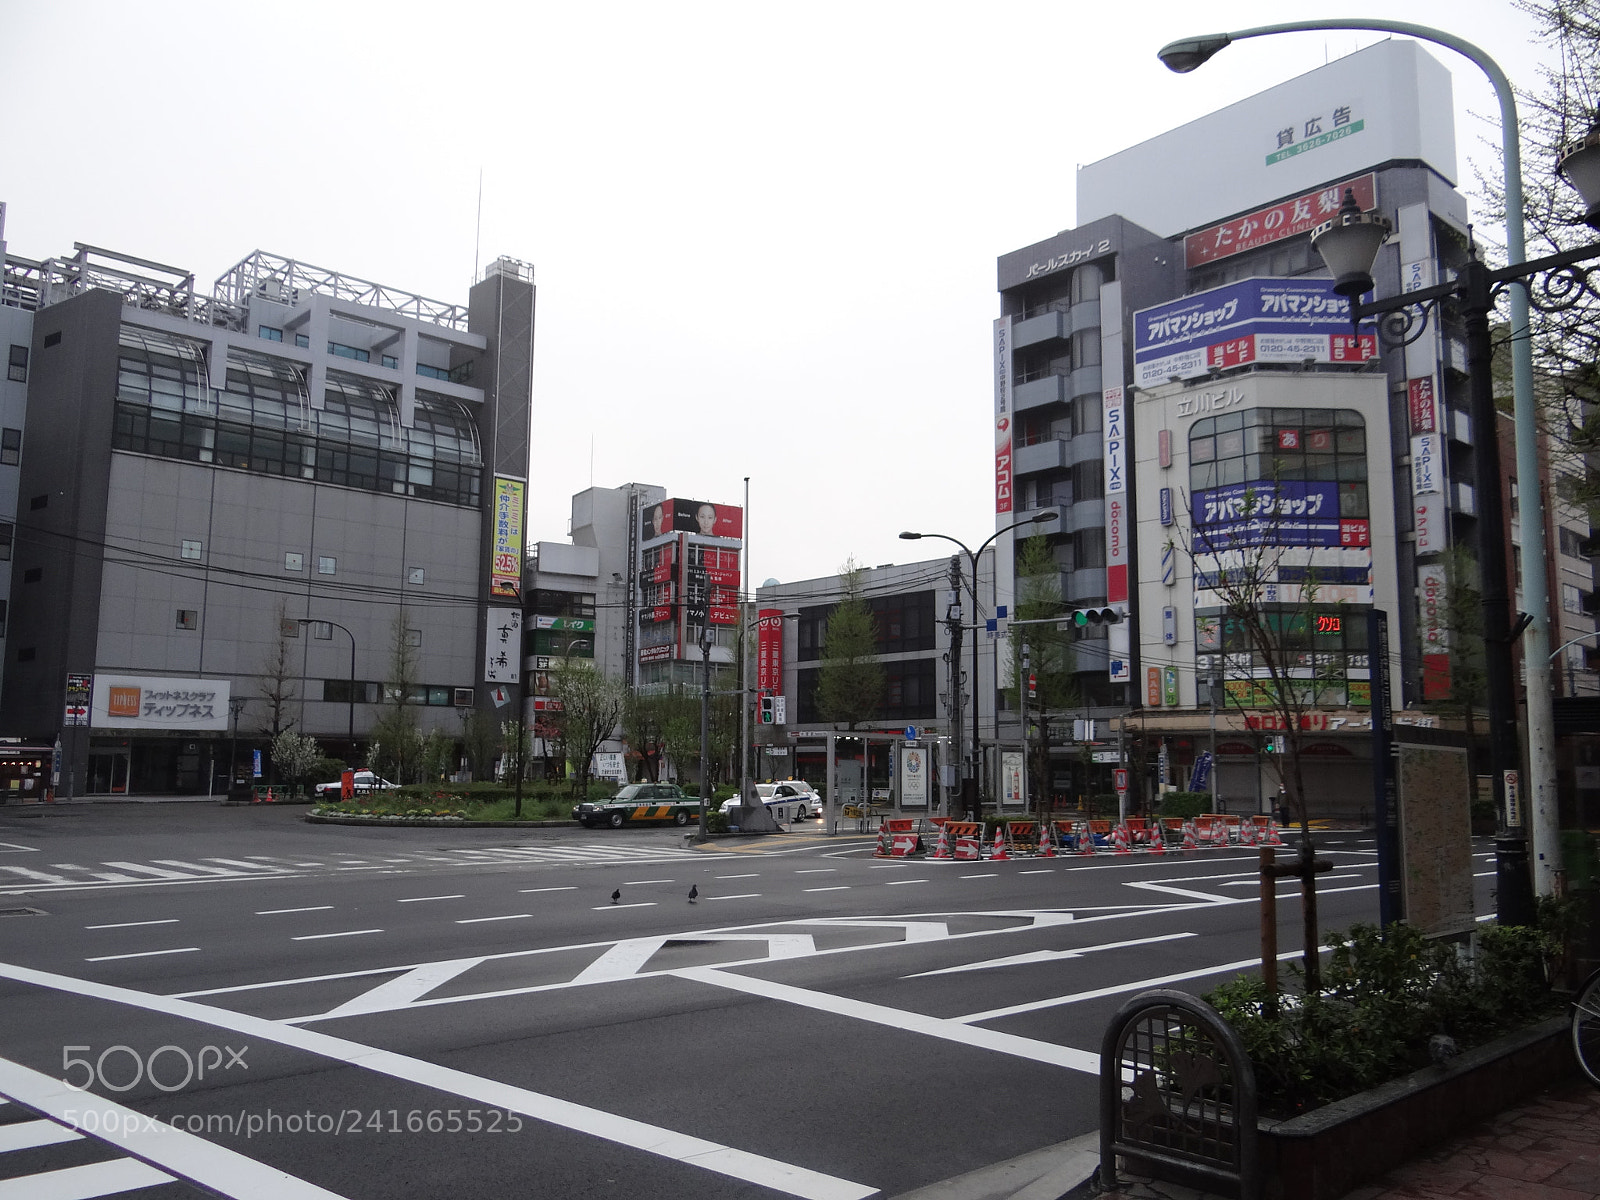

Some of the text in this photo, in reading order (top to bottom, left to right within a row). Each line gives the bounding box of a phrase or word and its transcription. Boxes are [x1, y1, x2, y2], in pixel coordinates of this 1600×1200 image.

[1275, 105, 1352, 150] 貸広告
[1214, 187, 1341, 248] たかの友梨
[1235, 218, 1318, 251] BEAUTY CLINIC
[1026, 239, 1111, 279] パールスカイ 2
[1147, 298, 1239, 341] アパマンショップ
[1176, 387, 1246, 418] 立川ビル
[1108, 409, 1121, 481] SAPIX
[1421, 437, 1432, 482] SAPIX
[997, 455, 1010, 499] アコム
[143, 703, 215, 718] ティップネス
[144, 690, 216, 701] フィットネスクラブ
